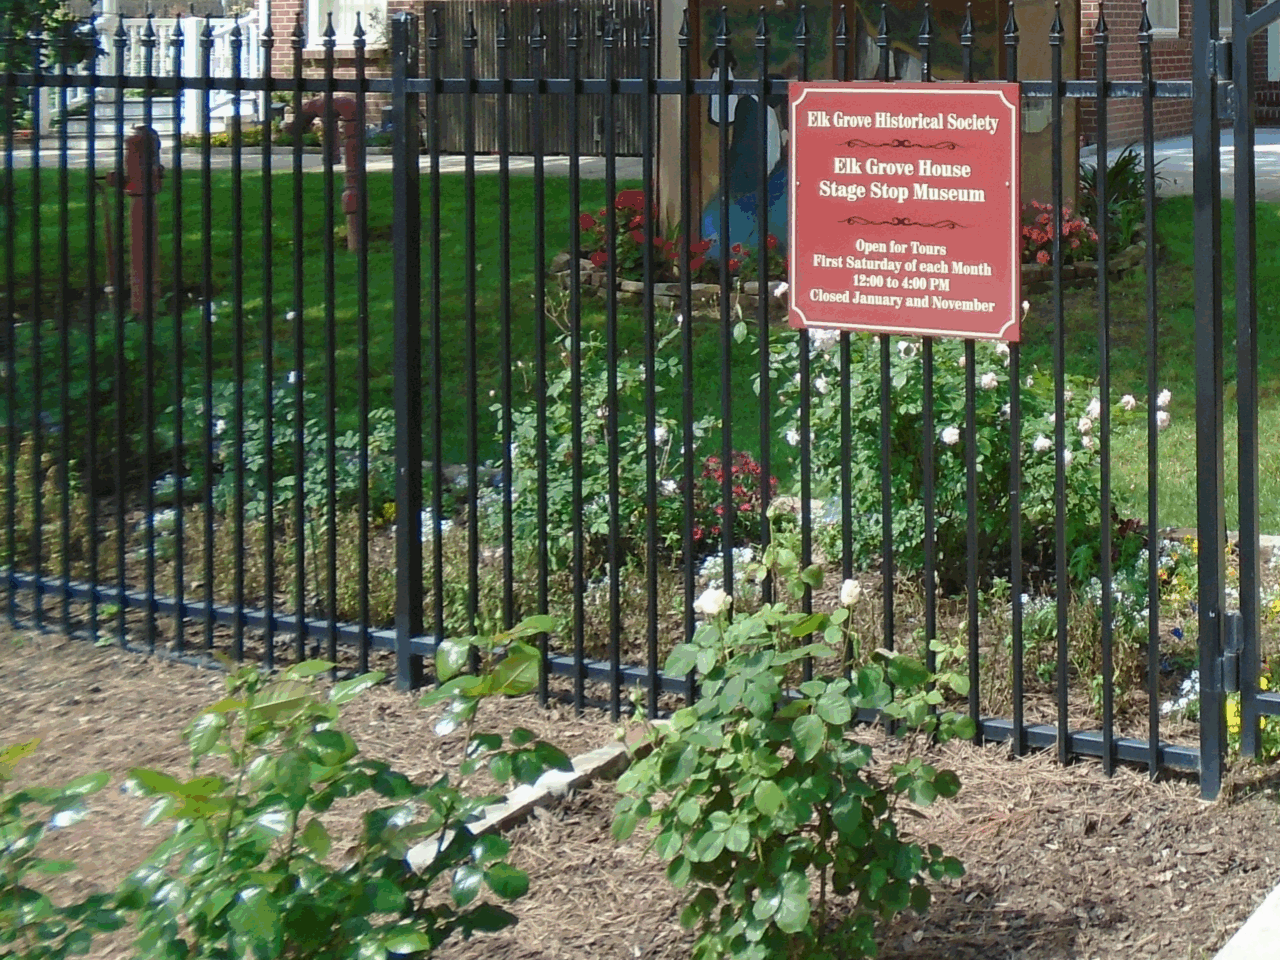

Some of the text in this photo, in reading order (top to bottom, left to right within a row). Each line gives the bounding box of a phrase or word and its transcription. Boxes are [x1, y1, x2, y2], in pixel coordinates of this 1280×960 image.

[807, 110, 999, 135] Elk Grove Historical Society
[834, 157, 971, 177] Elk Grove House
[819, 180, 985, 203] Stage Stop Museum
[855, 239, 946, 255] Open for Tours
[813, 254, 992, 276] First Saturday of each Month
[853, 274, 950, 291] 12:00 to 4:00 PM
[810, 289, 995, 312] Closed January and November
